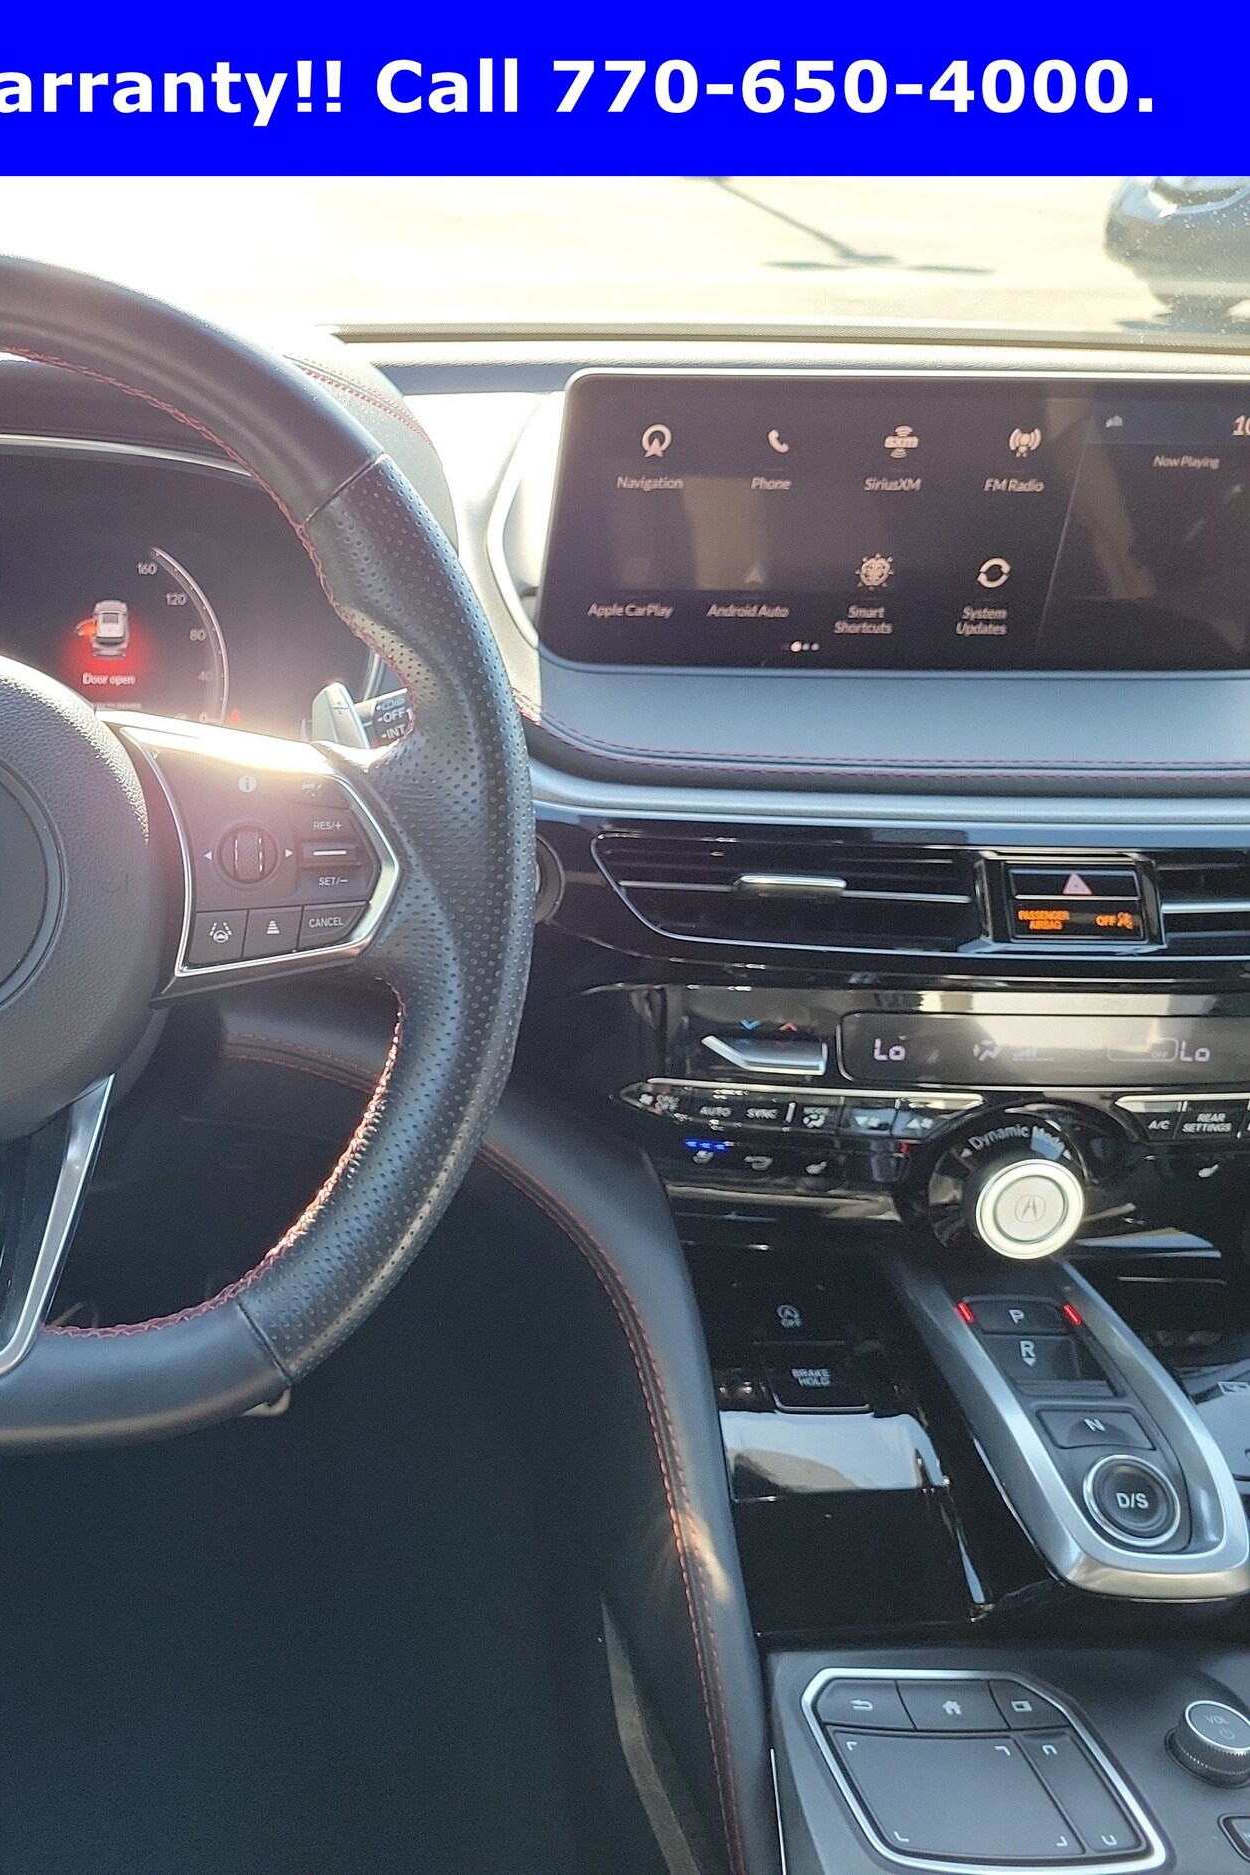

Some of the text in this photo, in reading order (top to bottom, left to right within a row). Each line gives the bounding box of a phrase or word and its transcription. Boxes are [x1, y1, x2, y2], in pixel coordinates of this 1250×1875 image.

[1153, 455, 1220, 470] Now Playing
[616, 476, 684, 491] Navigation
[751, 476, 792, 490] Phone
[863, 477, 922, 491] SiriusXM
[984, 478, 1044, 492] FM Radio
[136, 562, 158, 575] 160
[165, 592, 187, 606] 120
[587, 603, 674, 619] Apple CarPlay
[706, 603, 790, 618] Android Auto
[847, 605, 885, 619] Smart
[961, 606, 1008, 620] System
[189, 628, 207, 641] 80
[833, 621, 893, 634] Shortcuts
[955, 622, 1008, 636] Updates
[82, 672, 136, 687] Door open
[383, 707, 406, 723] OFF
[386, 724, 406, 739] INT
[309, 917, 344, 928] CANCEL
[1018, 910, 1070, 921] PASSENGER
[1029, 920, 1063, 930] AIRBAG
[700, 1106, 732, 1117] AUTO
[746, 1108, 779, 1119] SYNC
[1197, 1113, 1226, 1122] REAR
[1148, 1120, 1170, 1130] A/C
[1182, 1122, 1232, 1132] SETTINGS
[968, 1123, 1030, 1151] Dynamic
[1009, 1309, 1025, 1324] P
[1020, 1340, 1035, 1358] R
[791, 1368, 831, 1377] BRAKE
[798, 1377, 831, 1388] HOLD
[1084, 1418, 1106, 1431] N
[1116, 1492, 1149, 1509] D/S
[1204, 1714, 1231, 1725] VOL
